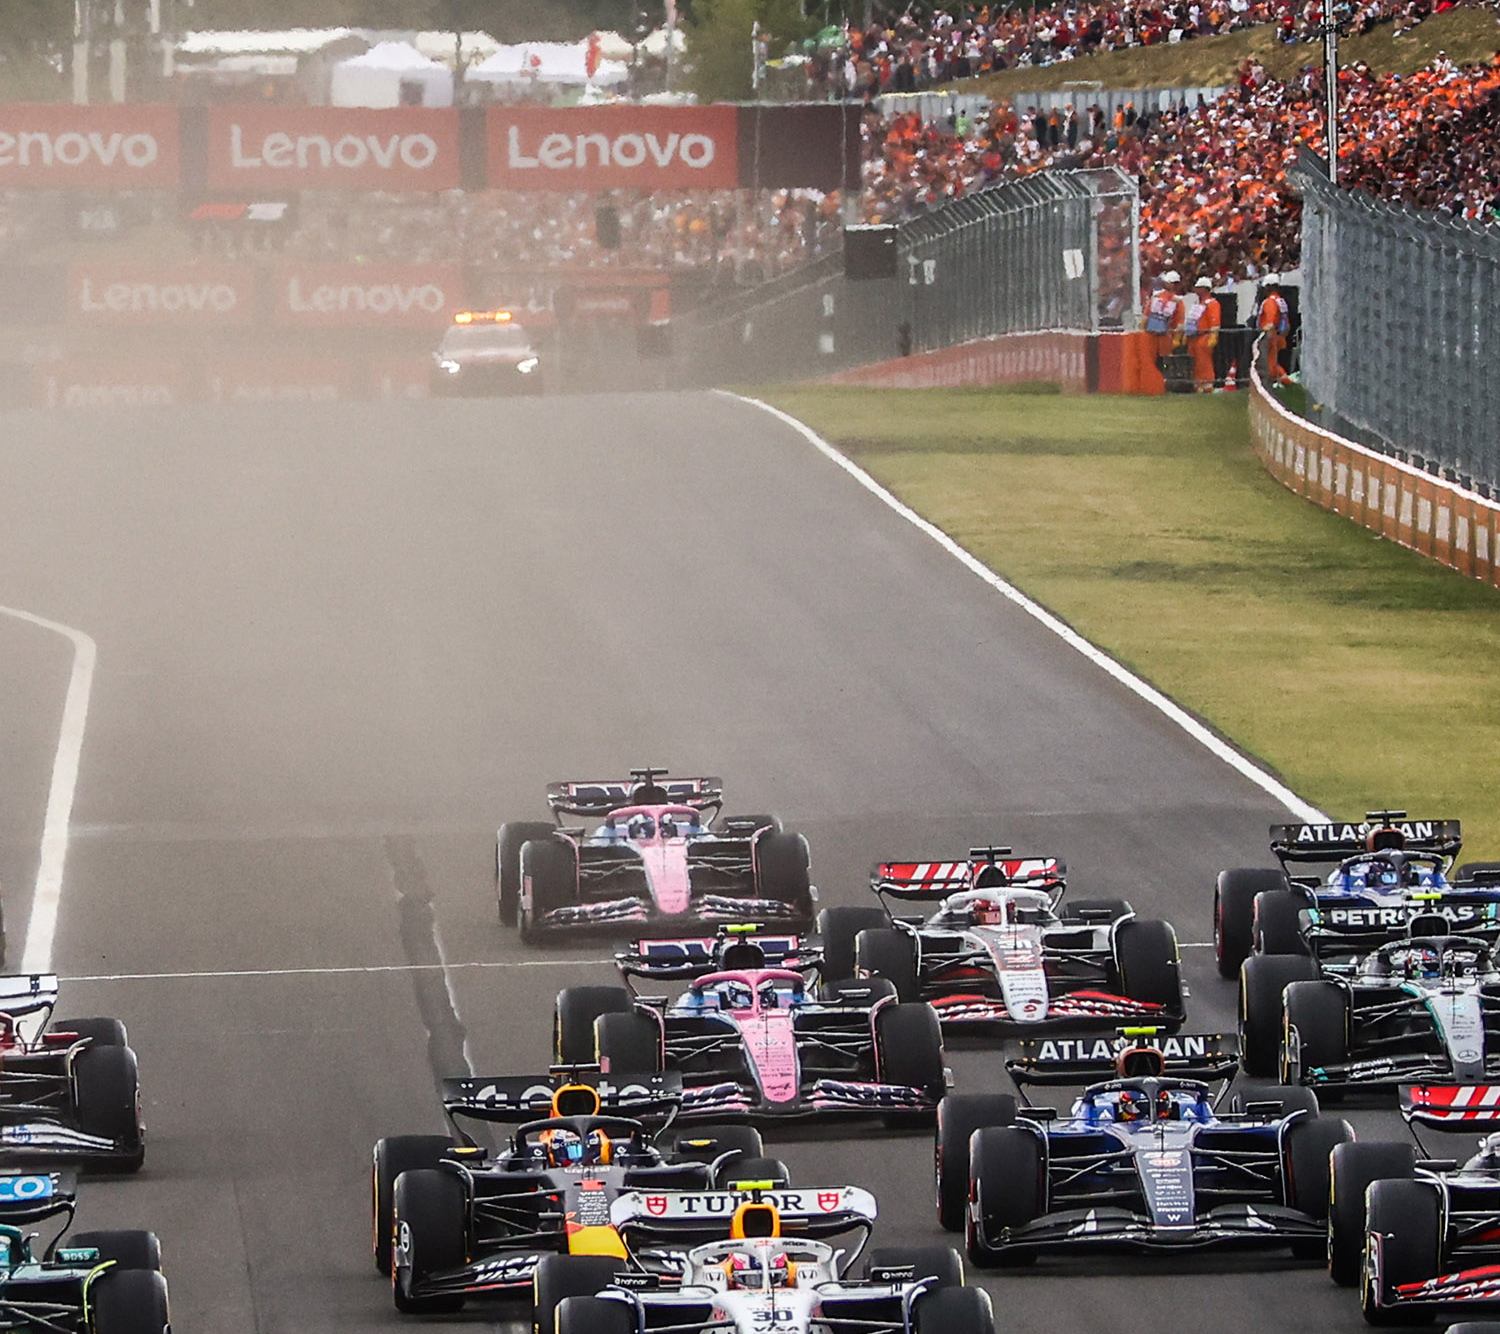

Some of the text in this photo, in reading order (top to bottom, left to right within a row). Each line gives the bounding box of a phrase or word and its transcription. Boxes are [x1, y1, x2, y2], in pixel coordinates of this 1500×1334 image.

[231, 123, 438, 168] Lenovo
[507, 125, 715, 168] Lenovo
[81, 278, 238, 312] Lenovo
[288, 278, 445, 313] Lenovo
[63, 1252, 91, 1261] BOSS
[752, 1310, 793, 1322] 30
